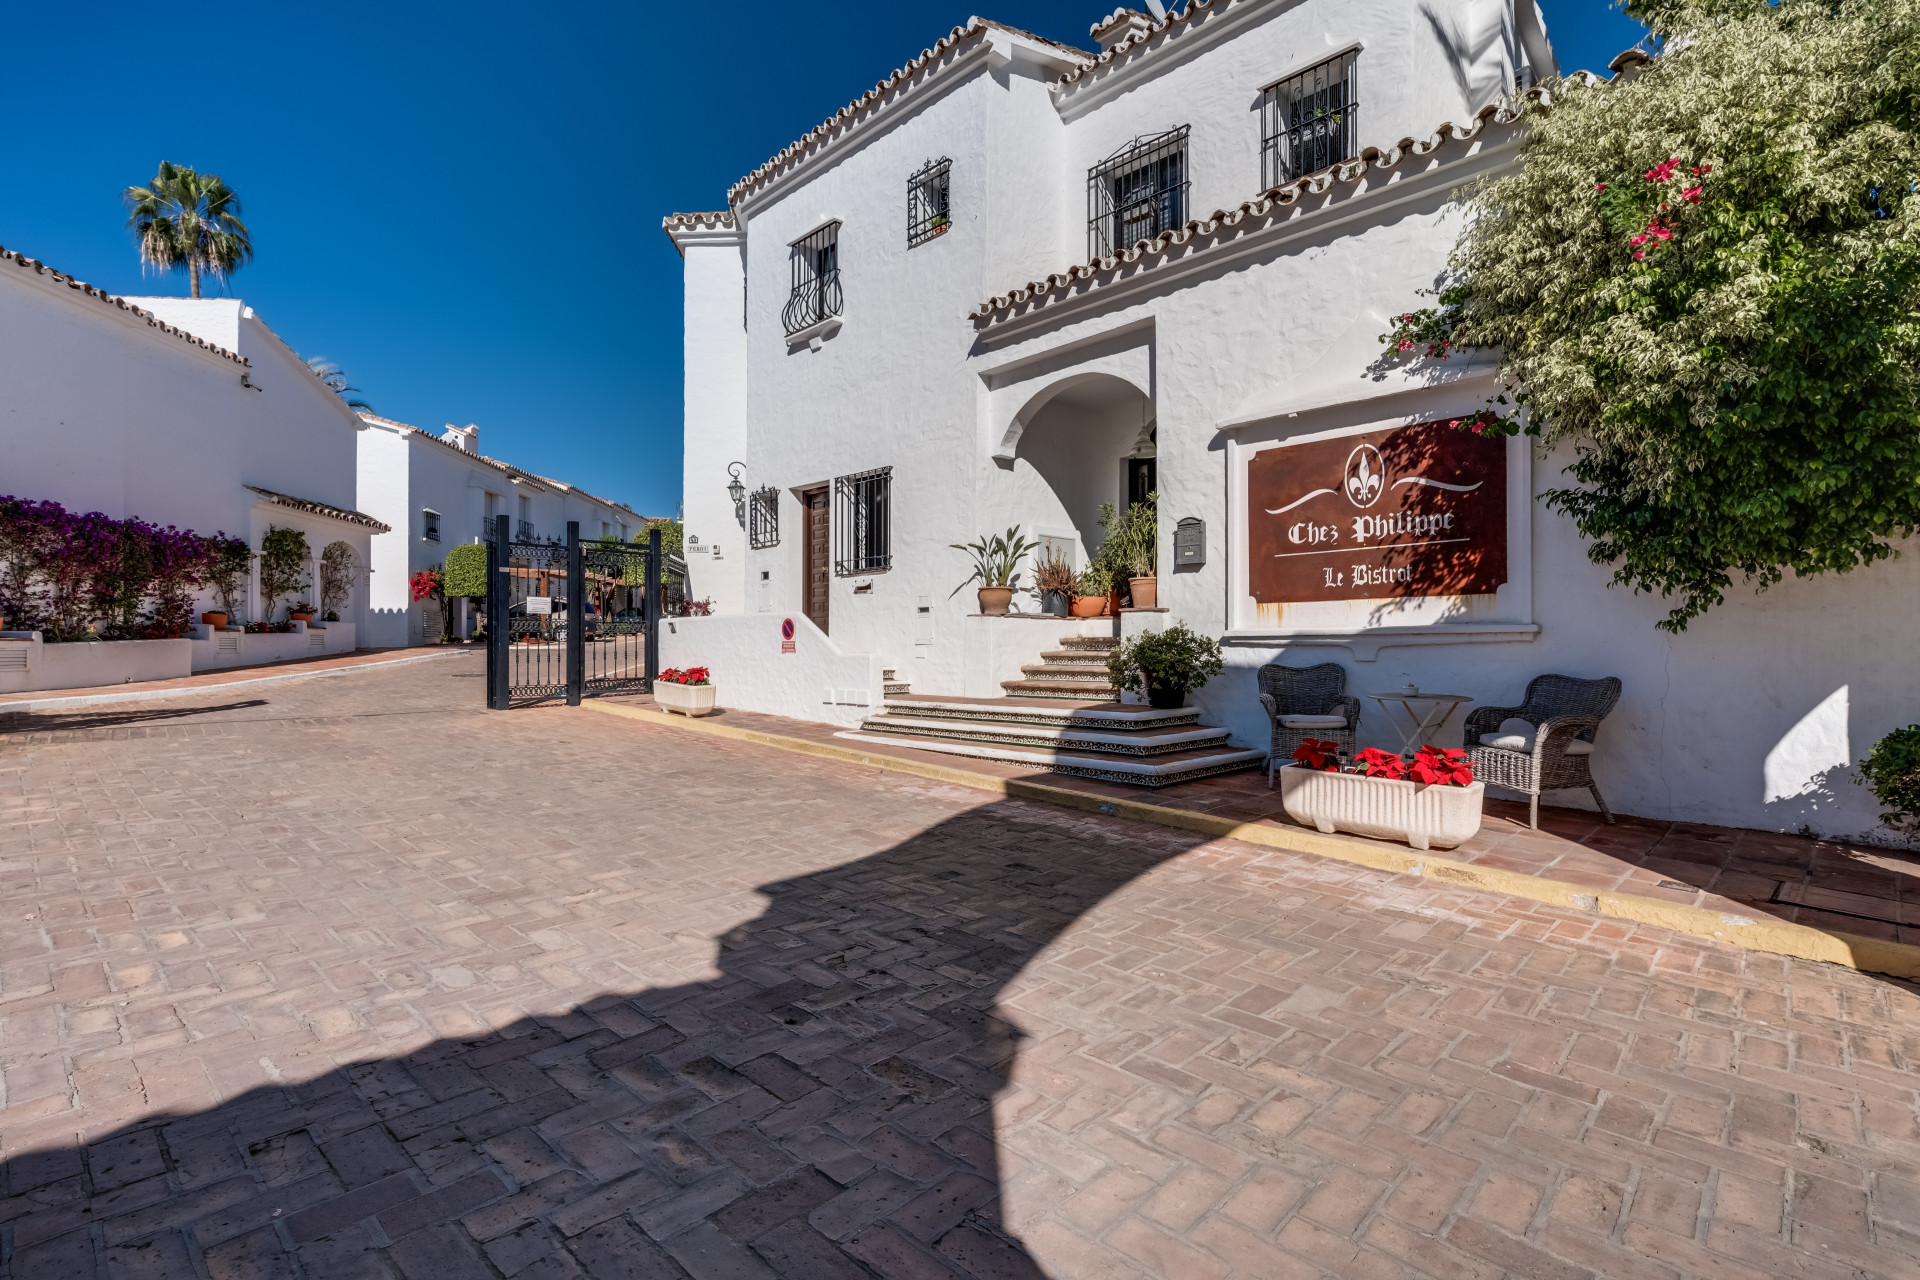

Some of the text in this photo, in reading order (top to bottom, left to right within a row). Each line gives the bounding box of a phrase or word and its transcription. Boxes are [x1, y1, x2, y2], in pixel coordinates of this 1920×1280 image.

[1288, 510, 1455, 546] Chez Philippe
[1323, 563, 1413, 589] Le Bistrot
